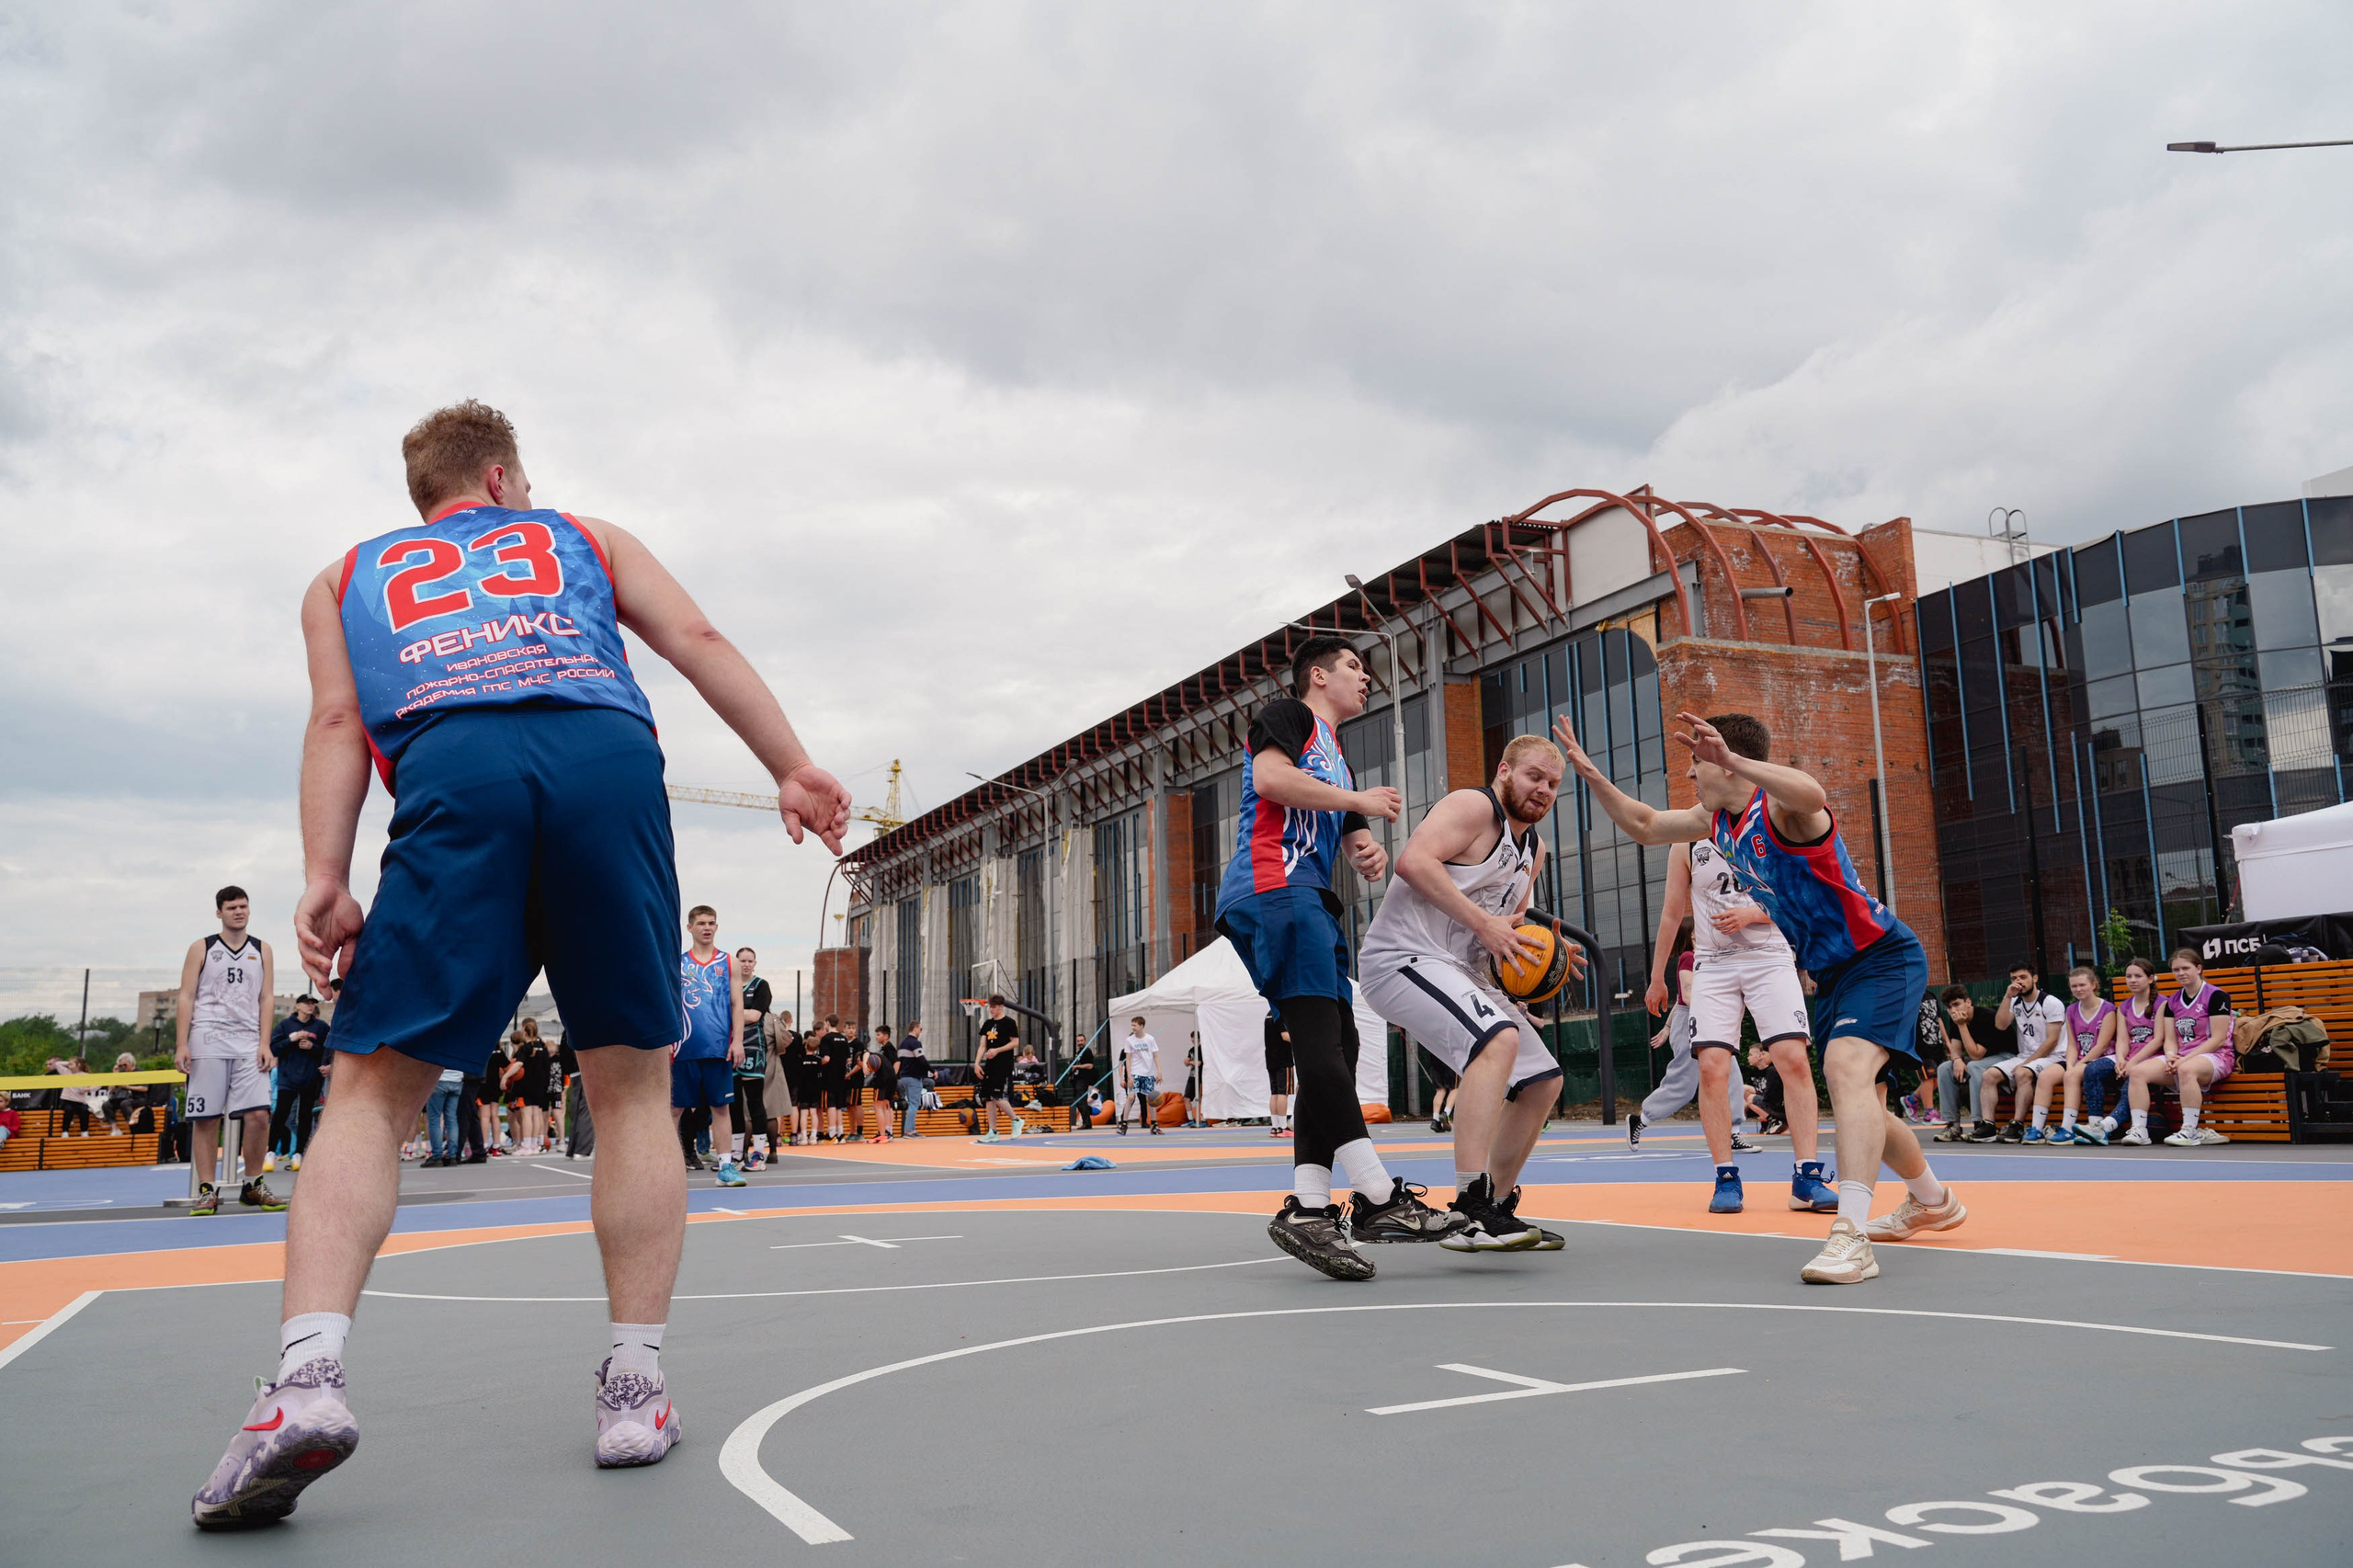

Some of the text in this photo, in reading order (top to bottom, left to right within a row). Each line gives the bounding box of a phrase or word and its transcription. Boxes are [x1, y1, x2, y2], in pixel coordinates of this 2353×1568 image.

[376, 521, 564, 634] 23
[399, 612, 581, 665] ФЕНИКС
[446, 643, 548, 673] ИВАНОВСКАЯ
[395, 667, 616, 719] АКАДЕМИЯ ГПС МЧС РОССИИ
[1751, 834, 1767, 858] 6
[2224, 937, 2261, 954] ПСБ
[227, 967, 243, 983] 53
[1471, 994, 1495, 1018] 4
[2023, 1023, 2035, 1037] 20
[188, 1097, 205, 1113] 53
